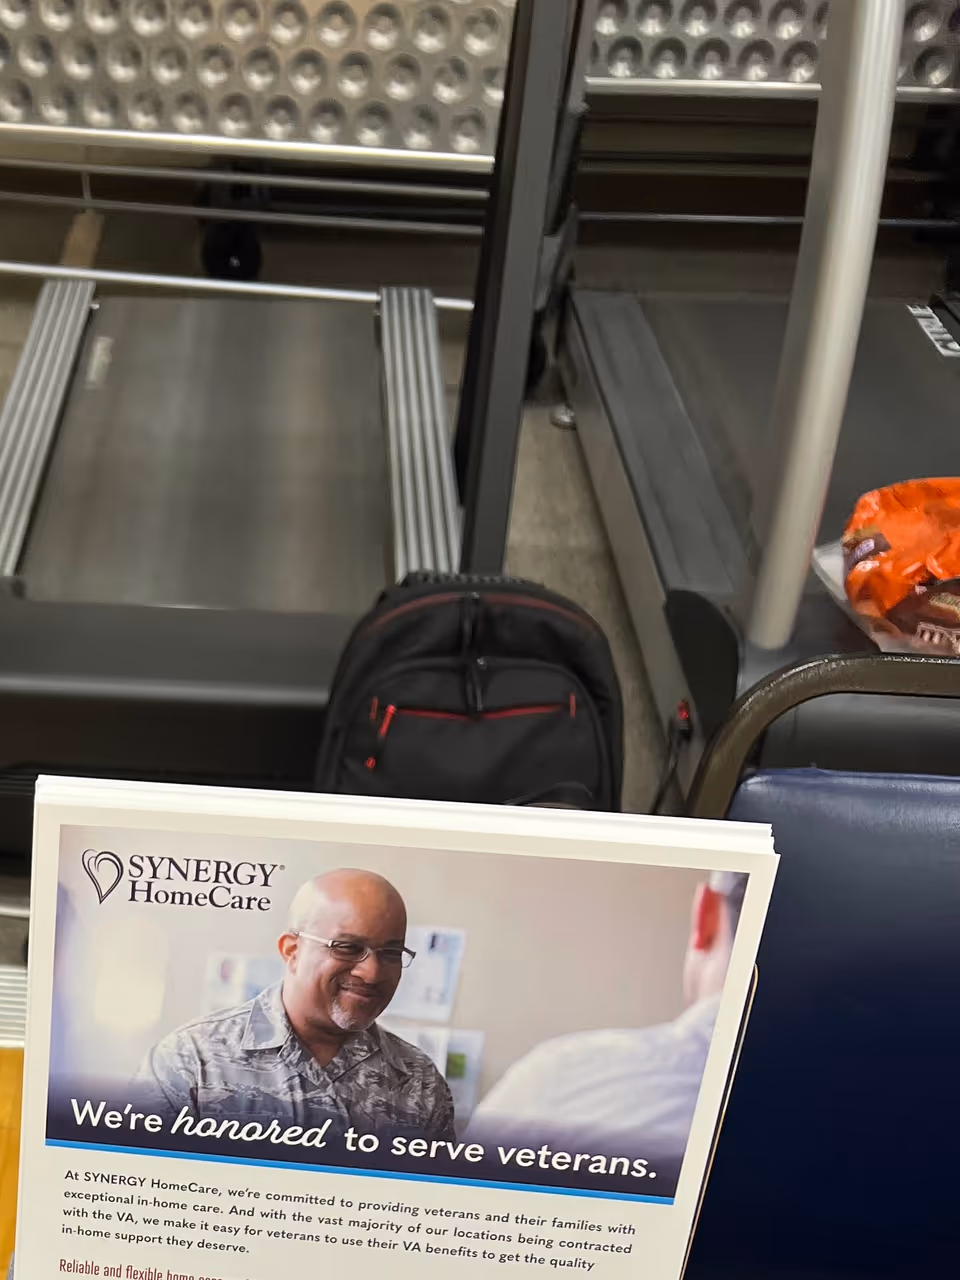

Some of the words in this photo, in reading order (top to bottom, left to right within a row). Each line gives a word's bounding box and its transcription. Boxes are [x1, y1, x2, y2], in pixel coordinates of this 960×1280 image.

[128, 880, 272, 912] HomeCare
[70, 1098, 164, 1133] We're
[171, 1106, 333, 1149] honored
[345, 1127, 379, 1153] to
[390, 1135, 485, 1162] serve
[497, 1144, 658, 1179] veterans.
[63, 1190, 134, 1205] exceptional
[137, 1195, 188, 1211] in-home
[192, 1204, 224, 1214] care.
[228, 1205, 255, 1217] And
[259, 1208, 287, 1221] with
[291, 1211, 313, 1223] the
[317, 1216, 344, 1226] vast
[348, 1218, 403, 1234] majority
[407, 1222, 422, 1234] of
[425, 1227, 449, 1236] our
[453, 1226, 513, 1243] locations
[517, 1232, 554, 1250] being
[558, 1240, 633, 1254] contracted
[64, 1170, 80, 1181] At
[83, 1171, 147, 1188] SYNERGY
[150, 1178, 222, 1197] HomeCare,
[227, 1187, 261, 1199] we're
[265, 1193, 336, 1206] committed
[339, 1198, 354, 1208] to
[357, 1201, 420, 1217] providing
[424, 1207, 481, 1221] veterans
[484, 1212, 510, 1223] and
[514, 1213, 548, 1226] their
[551, 1217, 603, 1232] families
[607, 1223, 636, 1235] with
[59, 1258, 100, 1276] Reliable
[103, 1263, 123, 1278] and
[61, 1223, 111, 1239] in-home
[114, 1232, 163, 1245] support
[166, 1235, 194, 1250] they
[196, 1238, 250, 1254] deserve.
[62, 1207, 89, 1218] with
[92, 1209, 113, 1221] the
[116, 1211, 139, 1225] VA,
[142, 1217, 160, 1226] we
[163, 1218, 197, 1230] make
[200, 1220, 209, 1231] it
[212, 1224, 241, 1237] easy
[243, 1224, 263, 1236] for
[266, 1229, 321, 1243] veterans
[324, 1234, 338, 1244] to
[341, 1237, 364, 1247] use
[367, 1237, 399, 1250] their
[402, 1240, 422, 1253] VA
[425, 1242, 478, 1258] benefits
[482, 1249, 496, 1260] to
[498, 1252, 521, 1264] get
[524, 1253, 546, 1265] the
[549, 1257, 596, 1272] quality
